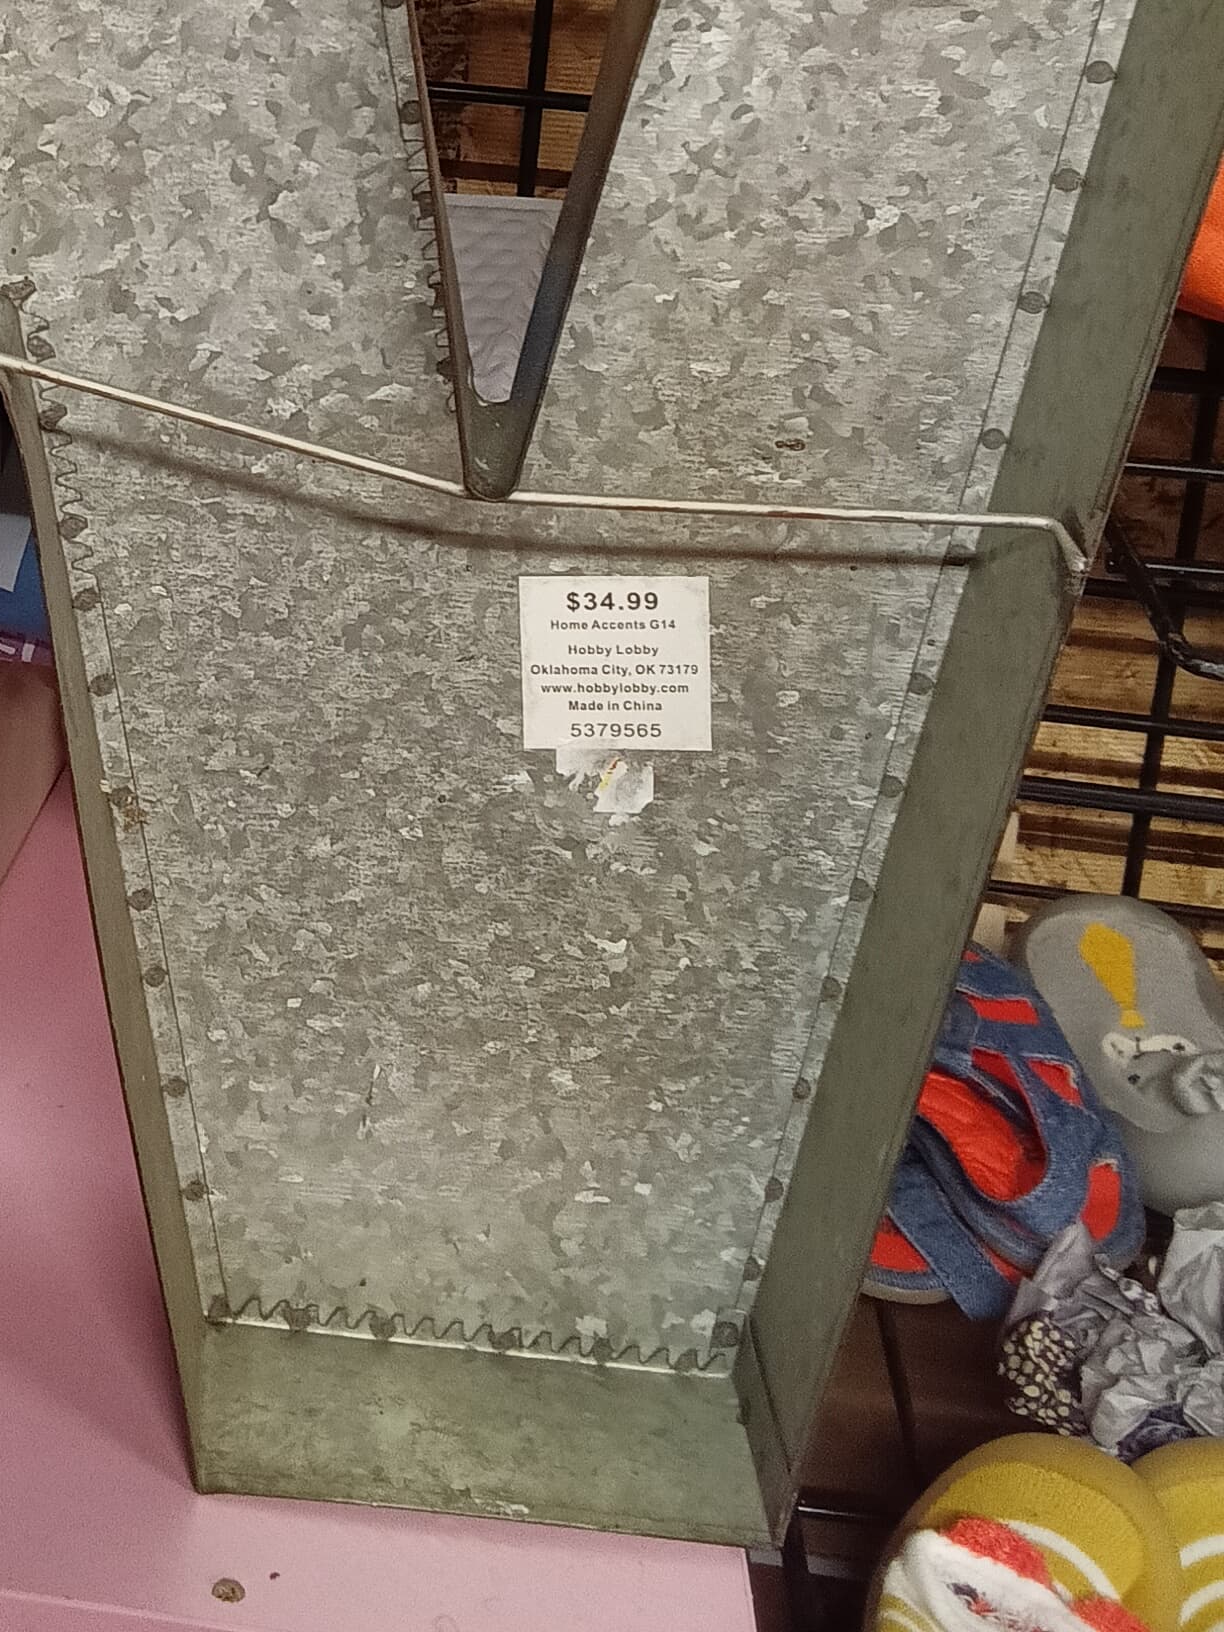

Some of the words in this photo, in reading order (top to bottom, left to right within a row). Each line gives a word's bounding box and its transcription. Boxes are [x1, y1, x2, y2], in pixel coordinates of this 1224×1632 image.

[566, 592, 659, 612] $34.99
[550, 620, 588, 630] Home
[591, 620, 646, 630] Accents
[649, 619, 676, 630] G14
[568, 644, 612, 657] Hobby
[616, 644, 659, 657] Lobby
[530, 664, 598, 675] Oklahoma
[601, 664, 632, 677] City,
[635, 664, 656, 675] OK
[659, 664, 699, 675] 73179
[540, 683, 689, 696] www.hobbylobby.com
[568, 700, 604, 711] Made
[607, 700, 620, 711] in
[623, 700, 663, 711] China
[570, 723, 663, 738] 5379565
